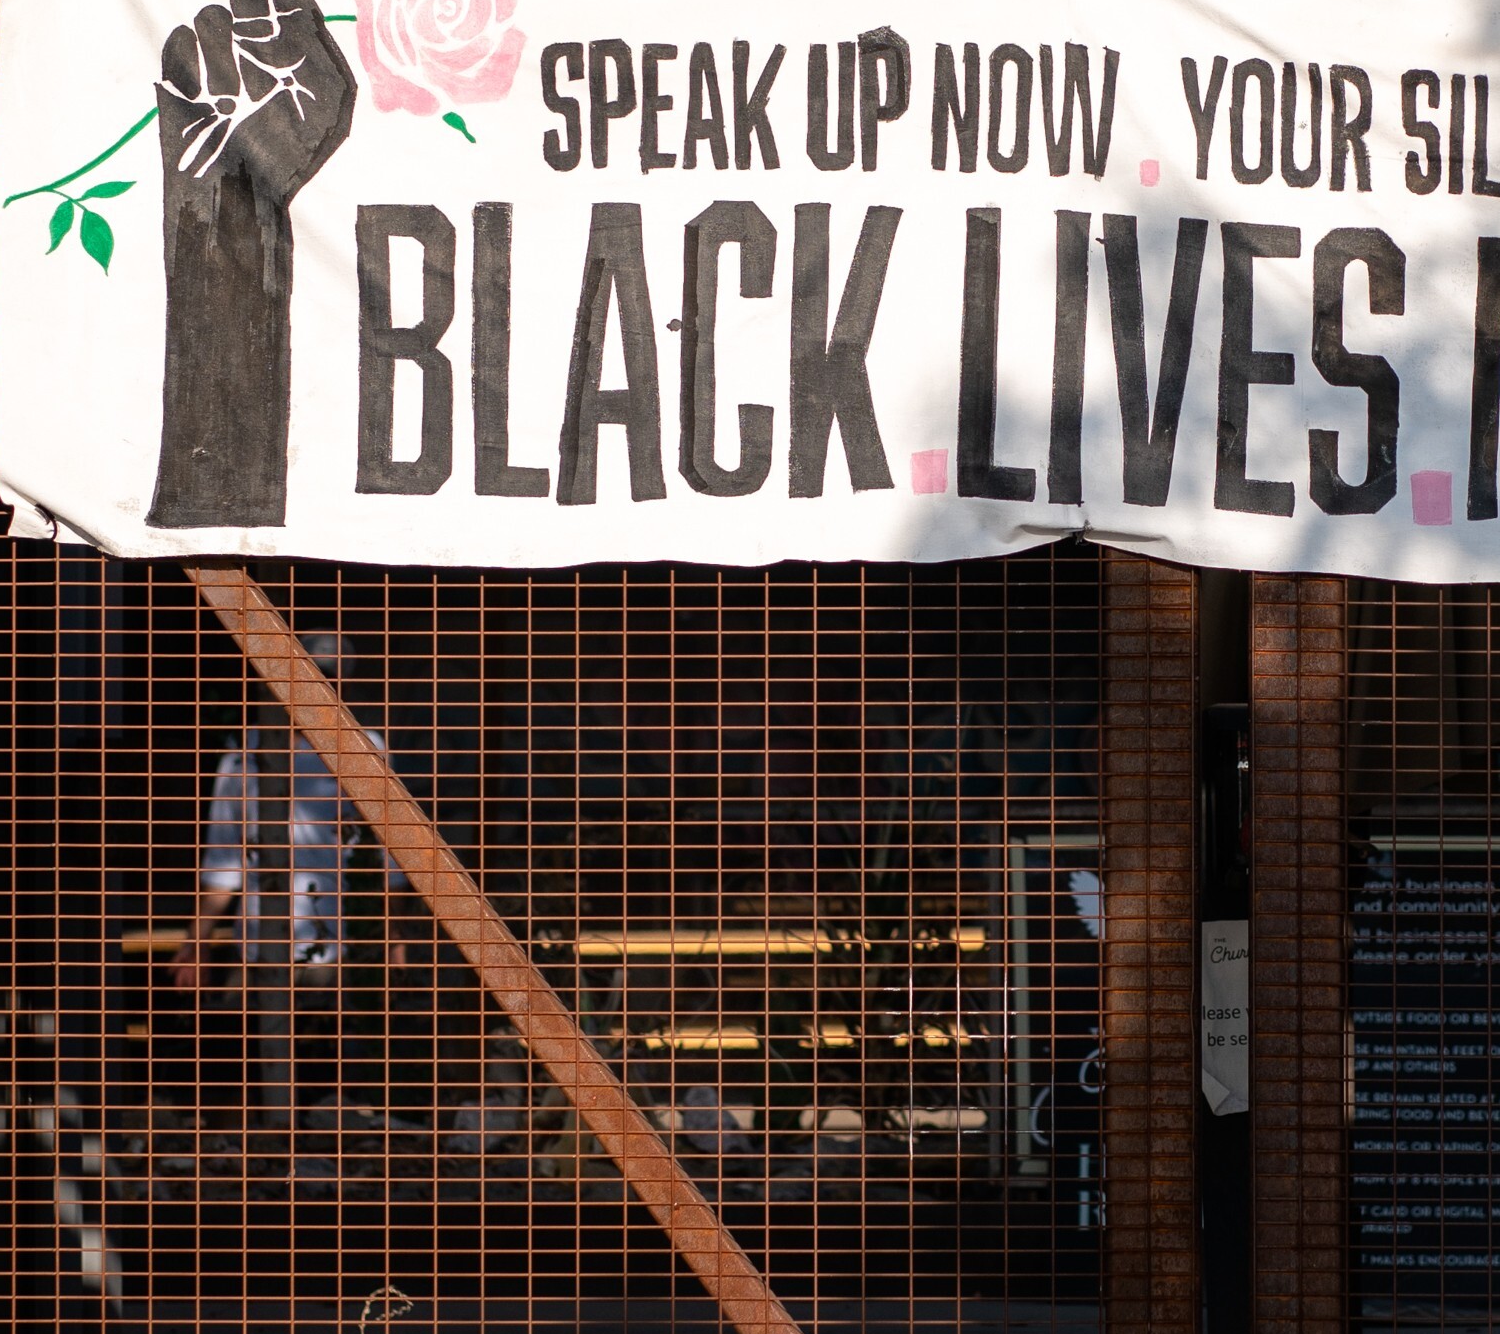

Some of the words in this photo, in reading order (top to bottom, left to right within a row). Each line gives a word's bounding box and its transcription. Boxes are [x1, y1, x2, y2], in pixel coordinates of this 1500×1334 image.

[540, 37, 787, 174] SPEAK
[806, 25, 911, 172] UP
[1180, 55, 1374, 192] YOUR
[1405, 877, 1495, 895] business
[1386, 899, 1500, 917] community
[1375, 927, 1492, 945] businesses
[1413, 949, 1468, 965] order
[1202, 1005, 1241, 1020] lease
[1406, 1012, 1447, 1026] FOOD
[1450, 1012, 1471, 1026] OR
[1207, 1032, 1226, 1047] be
[1372, 1044, 1439, 1056] MAINTAIN
[1452, 1044, 1485, 1056] FEET
[1372, 1060, 1402, 1072] AND
[1403, 1060, 1458, 1074] OTHERS
[1372, 1092, 1425, 1103] REMAIN
[1427, 1092, 1478, 1104] SEATED
[1393, 1108, 1435, 1122] FOOD
[1436, 1109, 1466, 1122] AND
[1410, 1140, 1433, 1152] OR
[1369, 1204, 1410, 1218] CARD
[1410, 1205, 1433, 1218] OR
[1434, 1205, 1488, 1218] DIGITAL
[1369, 1253, 1416, 1266] MASKS
